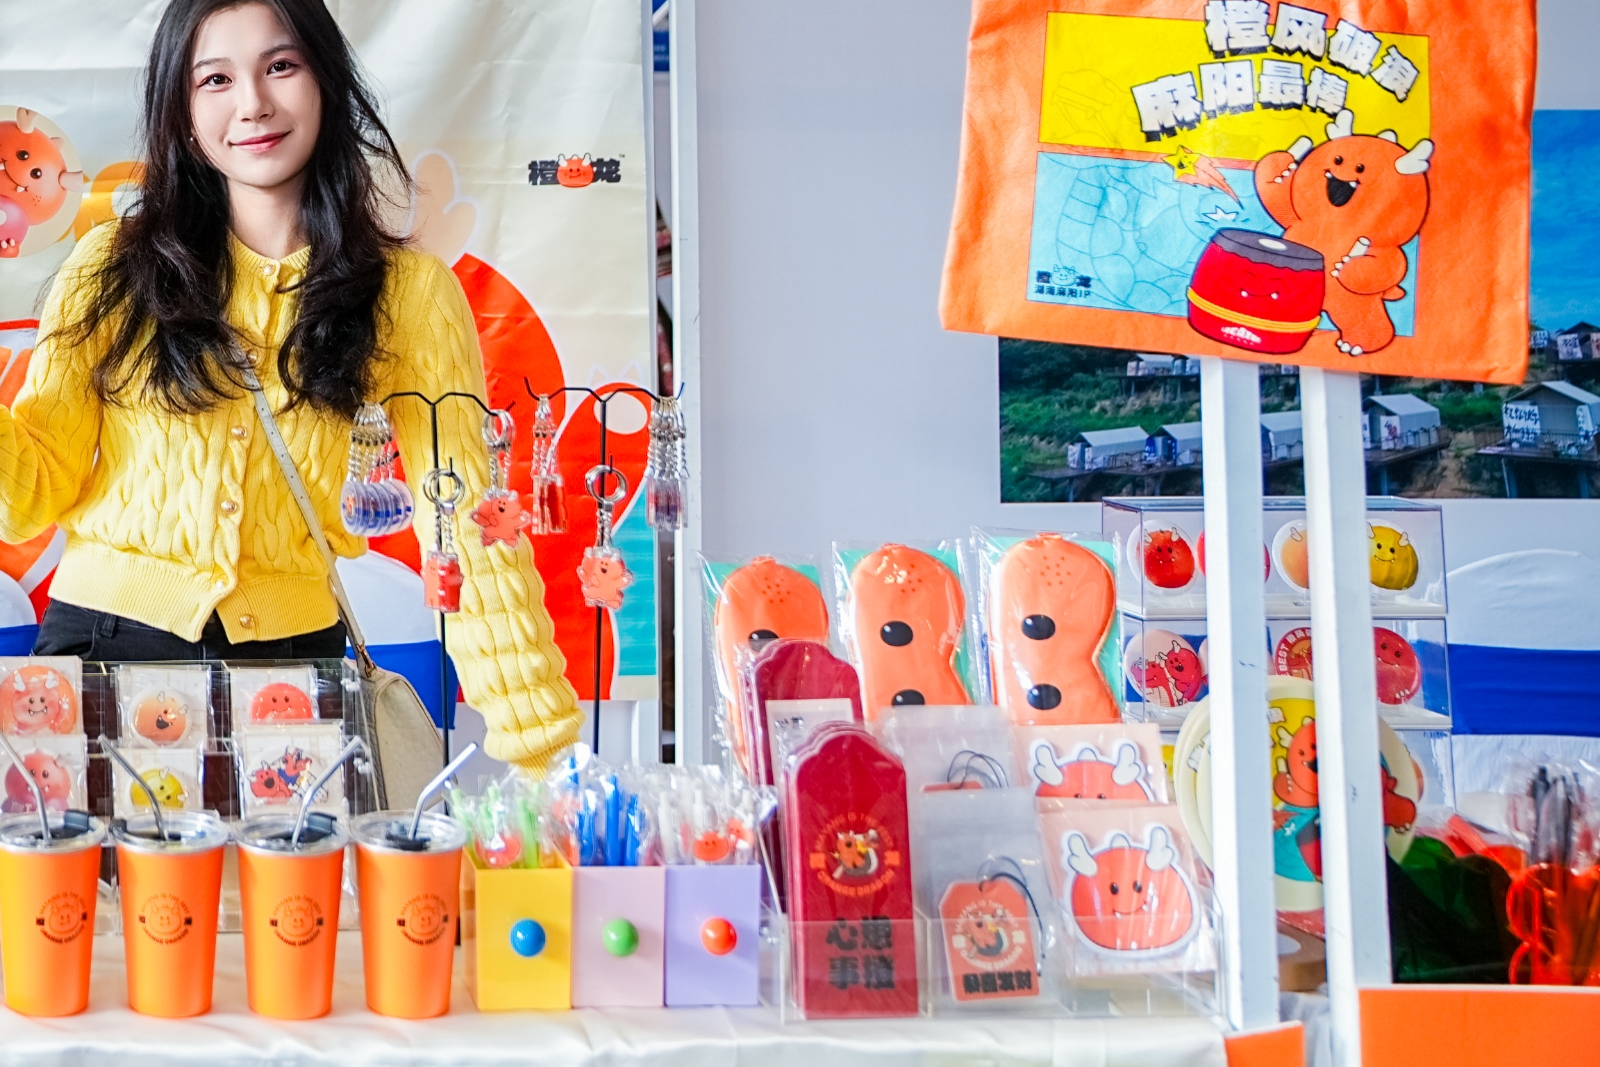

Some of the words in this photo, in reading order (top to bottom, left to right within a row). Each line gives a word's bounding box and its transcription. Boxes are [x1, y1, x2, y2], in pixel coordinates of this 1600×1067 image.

[1130, 57, 1349, 143] 麻阳最棒
[1278, 642, 1289, 672] BEST
